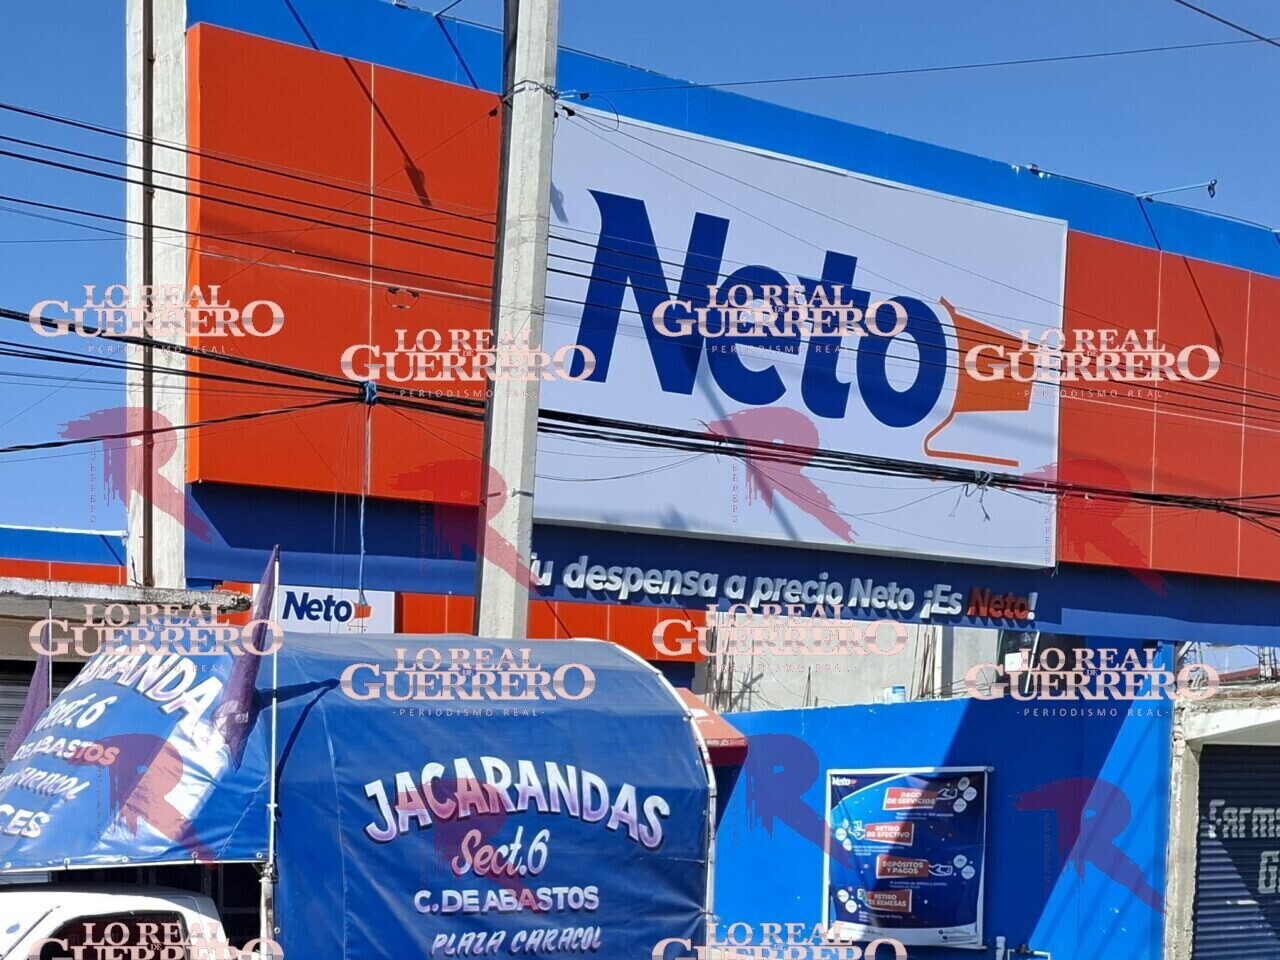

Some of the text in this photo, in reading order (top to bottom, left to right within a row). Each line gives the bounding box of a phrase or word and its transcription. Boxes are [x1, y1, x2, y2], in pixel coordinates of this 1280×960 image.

[577, 189, 947, 428] Neto
[530, 552, 554, 586] u
[563, 555, 719, 600] despensa
[724, 575, 747, 599] a
[751, 572, 844, 608] precio
[848, 578, 914, 611] Neto
[282, 591, 352, 622] Neto
[364, 756, 670, 848] JACARANDAS
[898, 797, 936, 805] SERVICIOS
[481, 886, 600, 911] ABASTOS
[431, 926, 602, 955] PLAZA CARACOL
